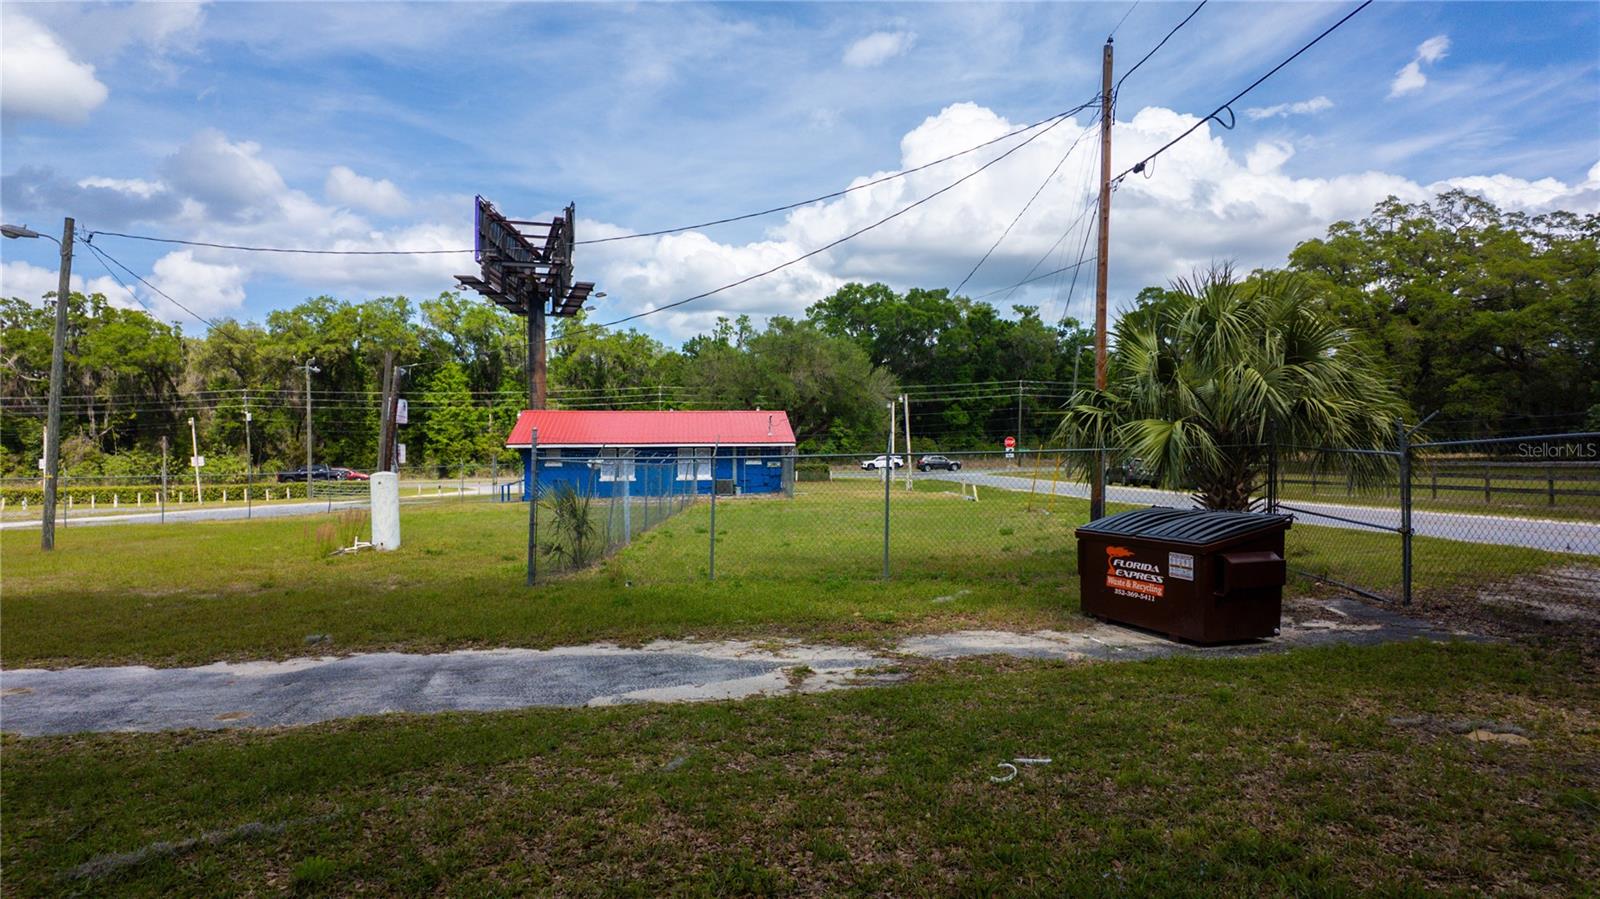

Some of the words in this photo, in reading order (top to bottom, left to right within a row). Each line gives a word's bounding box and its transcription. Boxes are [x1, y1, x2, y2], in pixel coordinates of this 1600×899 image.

[1113, 559, 1160, 573] FLORIDA
[1115, 569, 1164, 584] EXPRESS
[1107, 576, 1126, 587] Waste
[1132, 581, 1163, 597] Recycling
